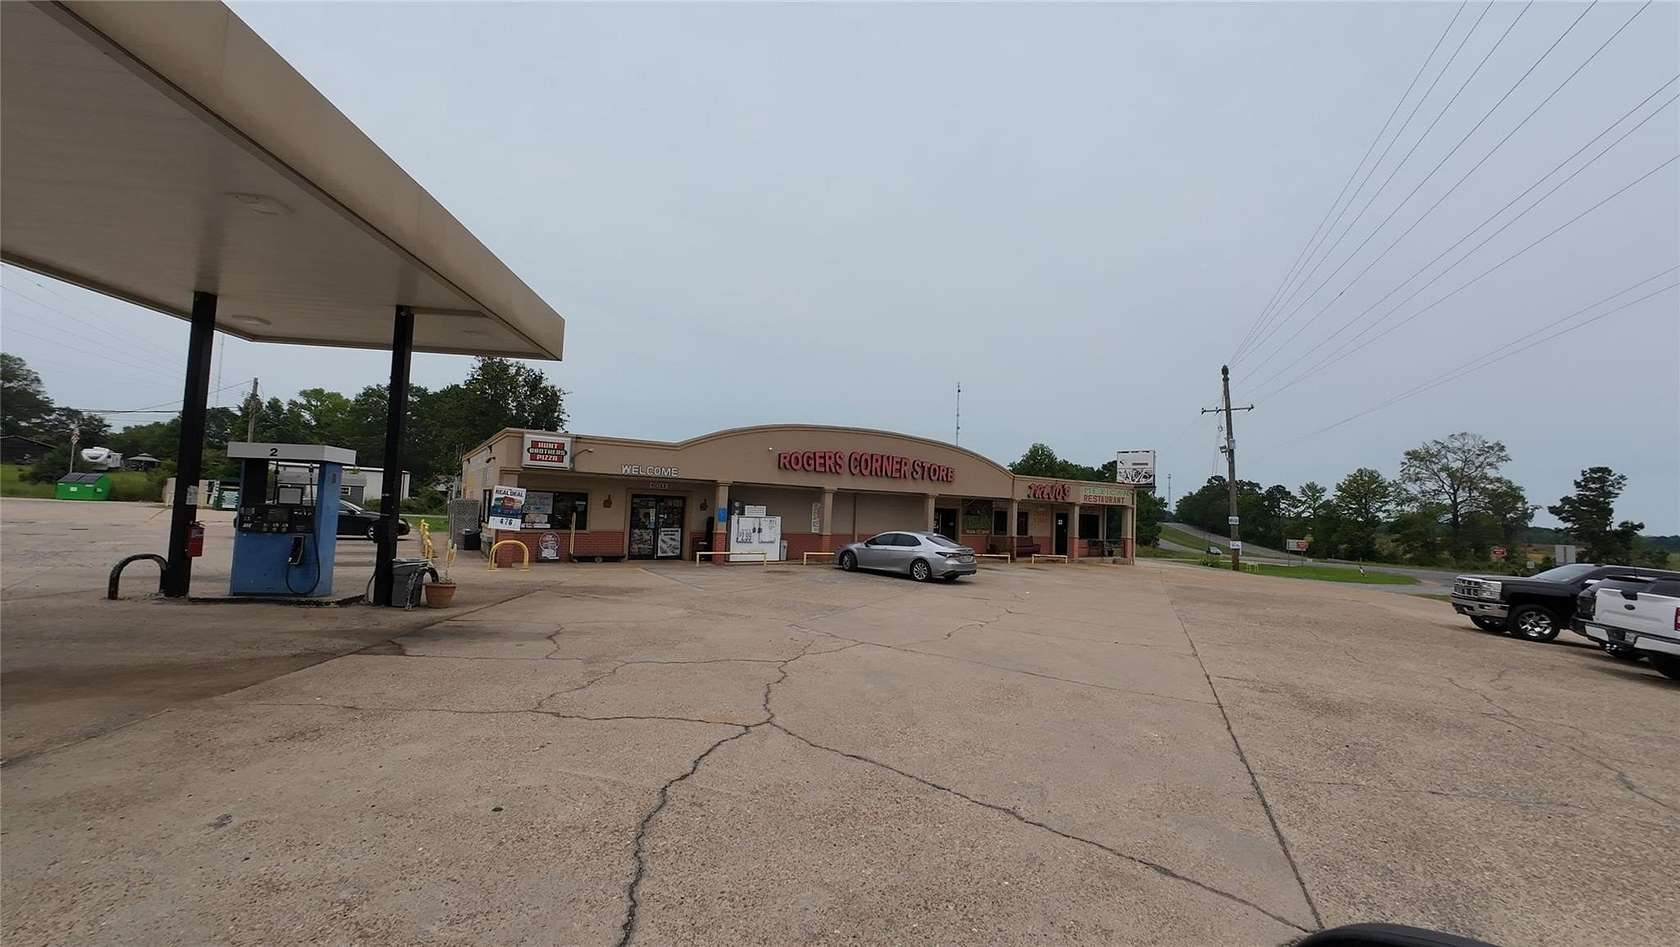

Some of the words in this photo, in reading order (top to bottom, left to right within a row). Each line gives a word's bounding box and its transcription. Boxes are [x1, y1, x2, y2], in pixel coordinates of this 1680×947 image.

[270, 448, 278, 456] 2
[621, 464, 680, 477] WELCOME
[778, 451, 846, 475] ROGERS
[848, 452, 911, 479] CORNER
[911, 459, 955, 483] STORE
[1083, 495, 1125, 504] RESTAURANT
